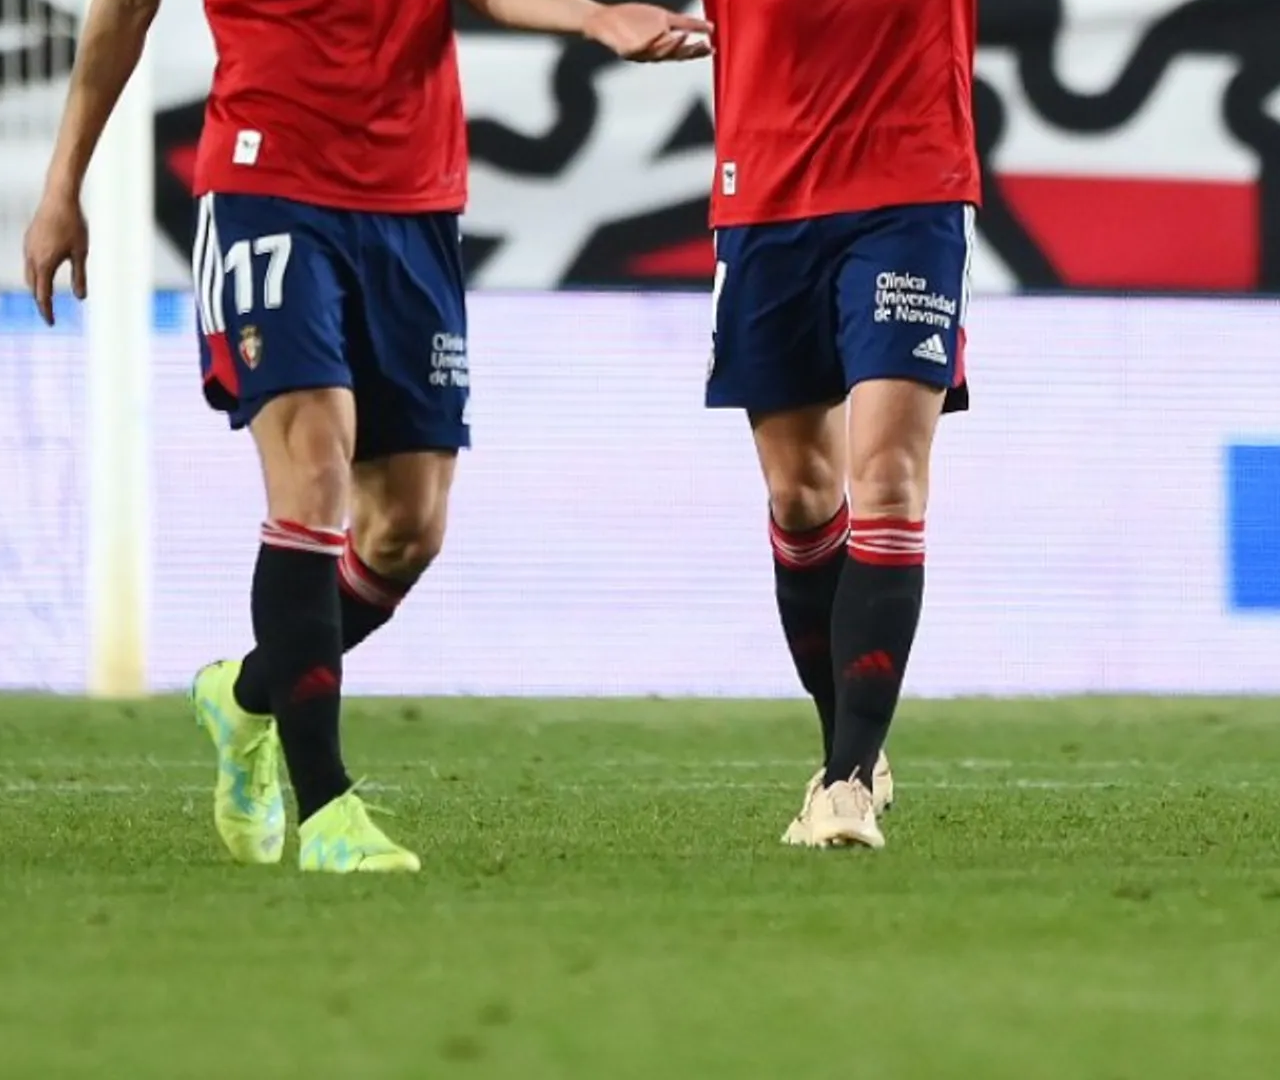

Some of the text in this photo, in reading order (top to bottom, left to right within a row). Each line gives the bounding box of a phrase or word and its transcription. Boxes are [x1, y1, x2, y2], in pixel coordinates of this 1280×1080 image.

[223, 232, 292, 316] 17
[873, 304, 891, 323] de
[874, 289, 957, 315] Universidad
